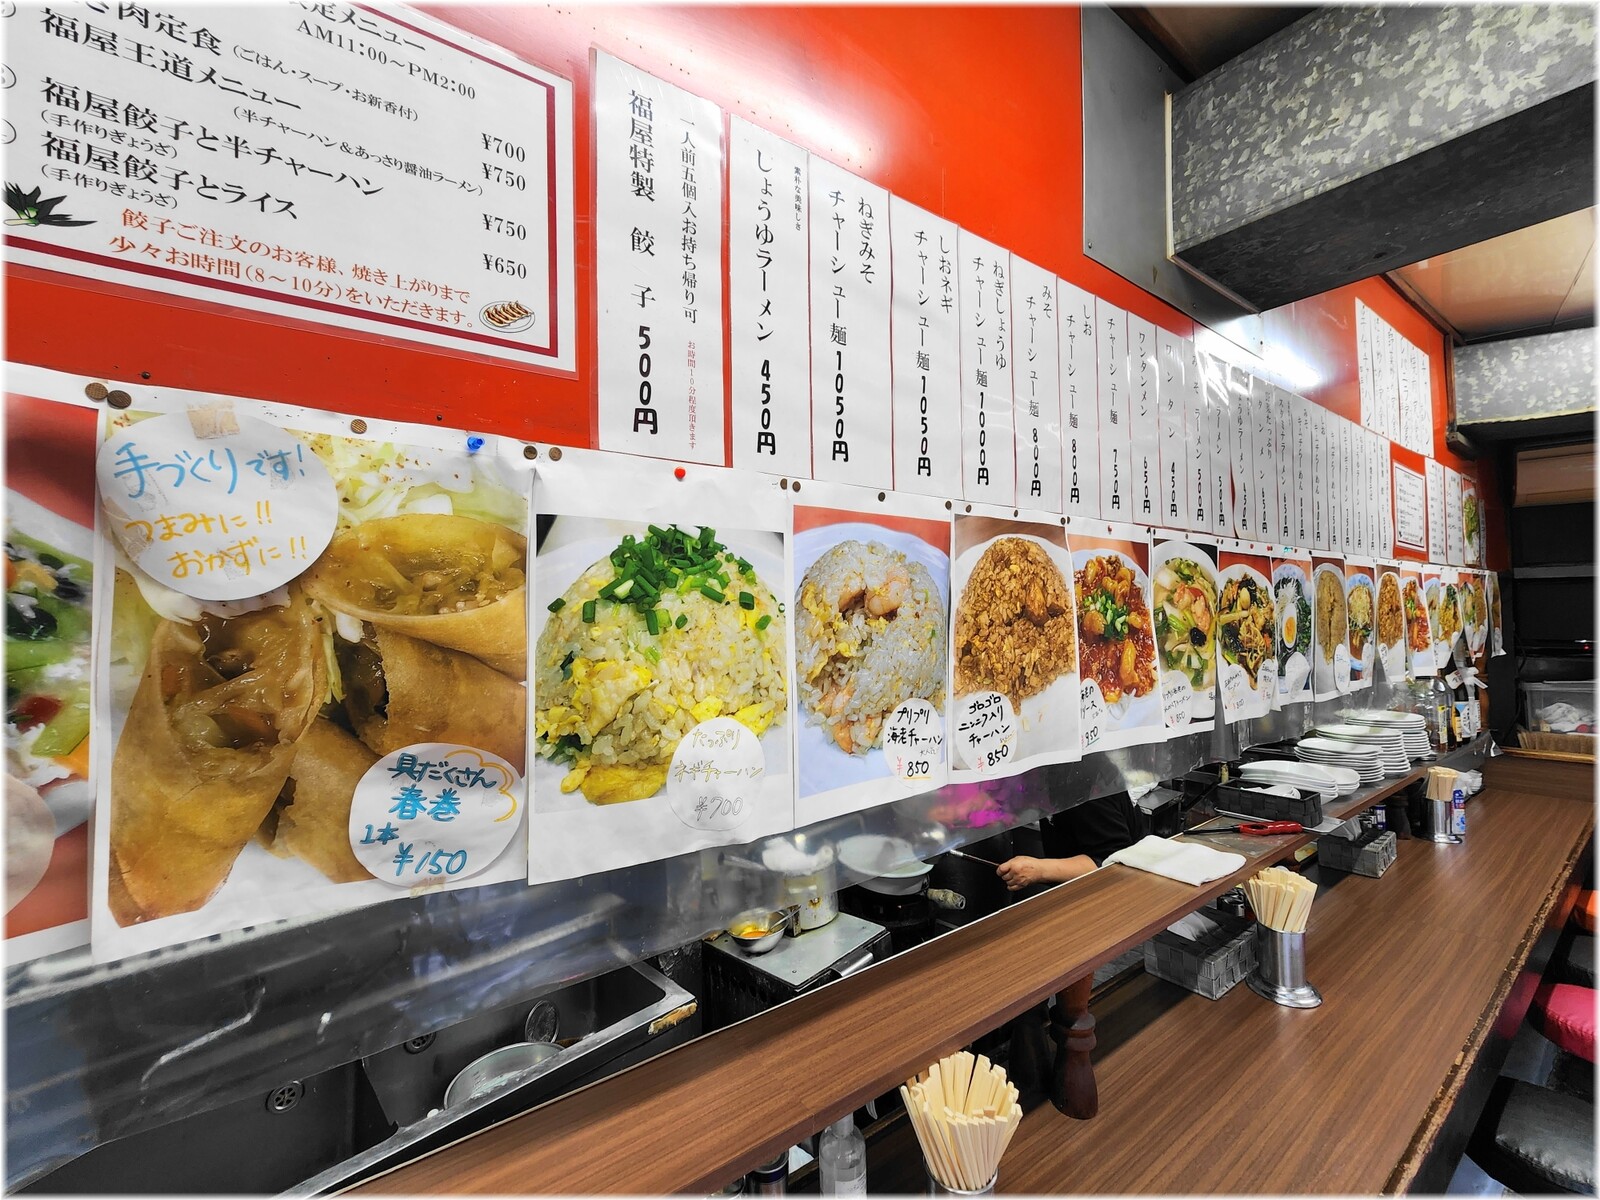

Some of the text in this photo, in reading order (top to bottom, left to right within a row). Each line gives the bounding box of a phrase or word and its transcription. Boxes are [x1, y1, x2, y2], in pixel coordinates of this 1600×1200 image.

[289, 2, 426, 51] 定メニュー
[40, 7, 302, 110] 福屋王道メニュー
[40, 76, 527, 241] 福屋餃子と半チャーハン ¥750
[481, 132, 526, 163] ¥700
[481, 162, 527, 192] ¥750
[41, 131, 298, 219] 福屋餃子とライス
[482, 252, 528, 280] ¥650
[679, 119, 699, 324] 一人前五個入お持ち帰り可
[628, 89, 659, 435] 福屋特製 餃子 500円
[857, 196, 876, 285] ねぎみそ
[754, 148, 777, 456] しょうゆラーメン 450円
[938, 235, 953, 315] しおネギ
[1042, 284, 1053, 319] みそ
[829, 189, 849, 463] チャーシュー麺 1050円
[992, 260, 1007, 370] ねぎしょうゆ
[1082, 304, 1093, 337] しお
[913, 230, 932, 477] チャーシュー麺 1050円
[972, 256, 989, 487] チャーシュー麺 1000円
[1025, 295, 1042, 498] チャーシュー麺 800円
[1066, 314, 1080, 504] チャーシュー麺 800円
[1138, 331, 1151, 514] ワンタンメン 650円
[1165, 344, 1178, 518] ワンタン 450円
[1111, 448, 1121, 510] 750円
[897, 707, 930, 725] プリプリ
[968, 694, 1002, 715] ゴロゴロ
[692, 728, 741, 751] たっぷり
[887, 726, 943, 747] 海老チャーハン
[968, 725, 1010, 748] チャーハン
[387, 752, 498, 789] 具だくさん
[674, 760, 763, 783] ネギチャーハン
[359, 821, 400, 845] 1本
[388, 783, 462, 822] 春巻
[694, 796, 744, 822] ¥700
[392, 842, 468, 877] ¥150
